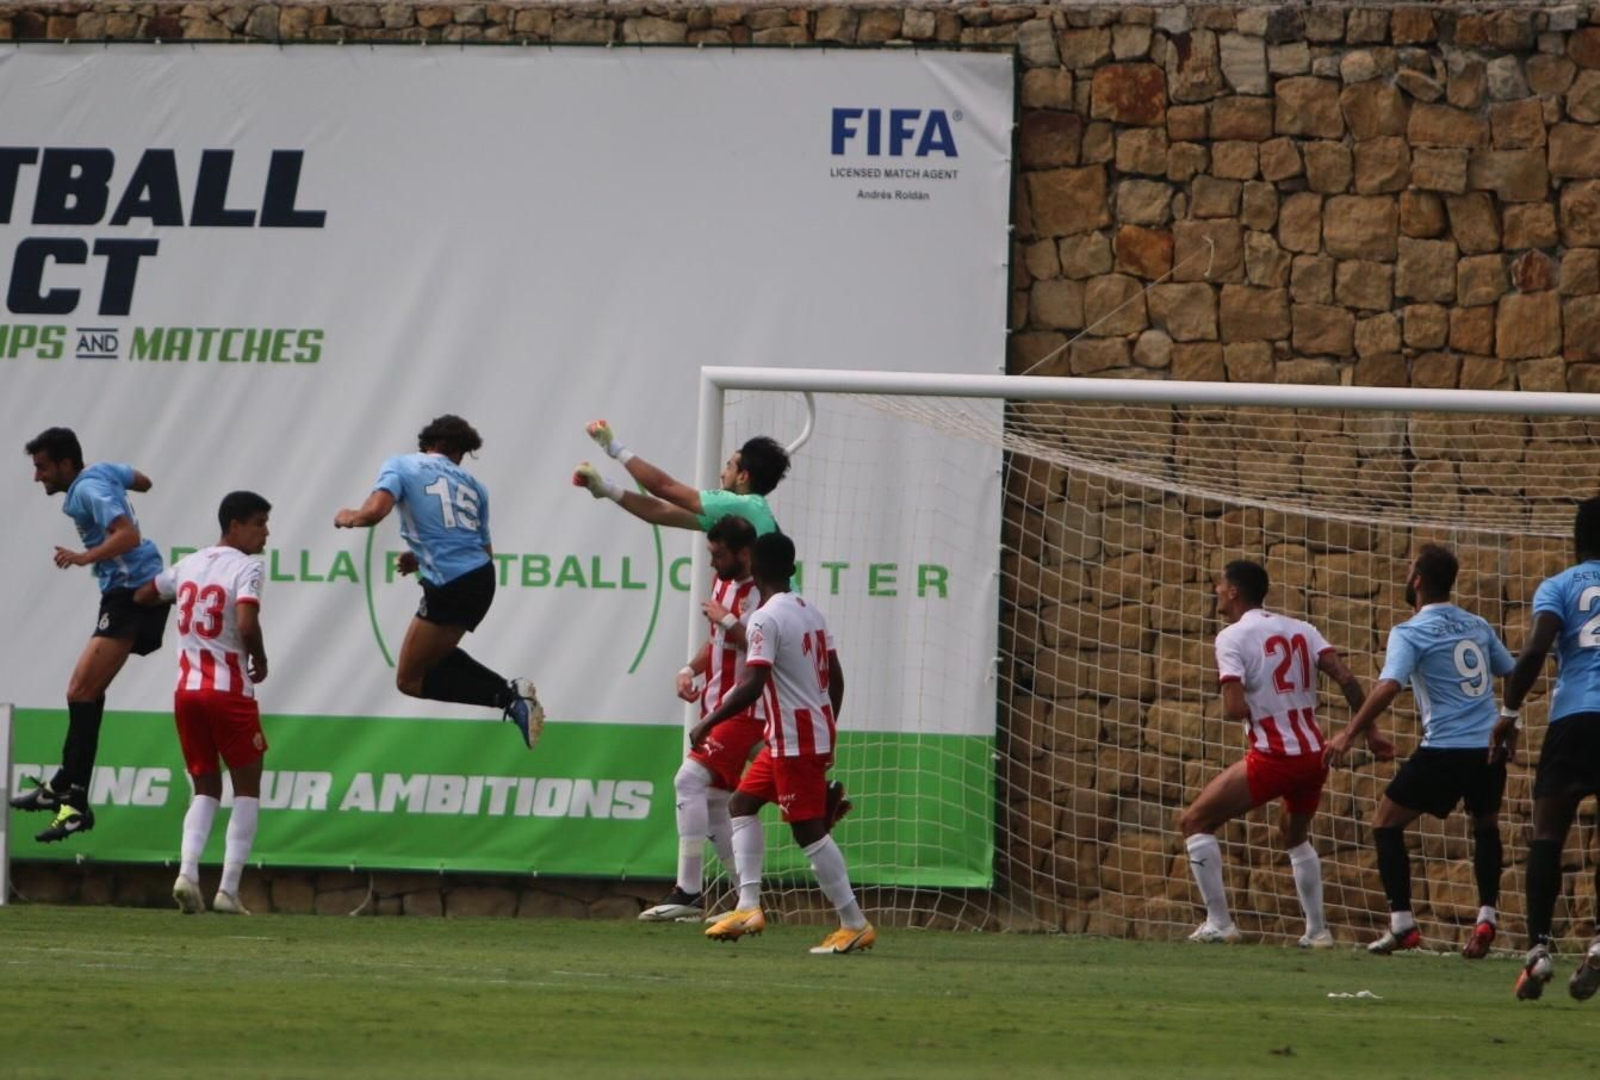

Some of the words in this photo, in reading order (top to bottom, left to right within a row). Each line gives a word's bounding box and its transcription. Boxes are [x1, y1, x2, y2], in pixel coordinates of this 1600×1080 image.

[830, 167, 881, 179] LICENSED
[884, 169, 920, 179] MATCH
[922, 169, 959, 180] AGENT
[6, 237, 160, 316] CT
[76, 333, 119, 352] AND
[129, 326, 325, 363] MATCHES
[425, 475, 481, 531] 15
[177, 581, 227, 640] 33
[1264, 633, 1311, 695] 21
[1453, 639, 1489, 697] 9
[338, 771, 654, 820] AMBITIONS
